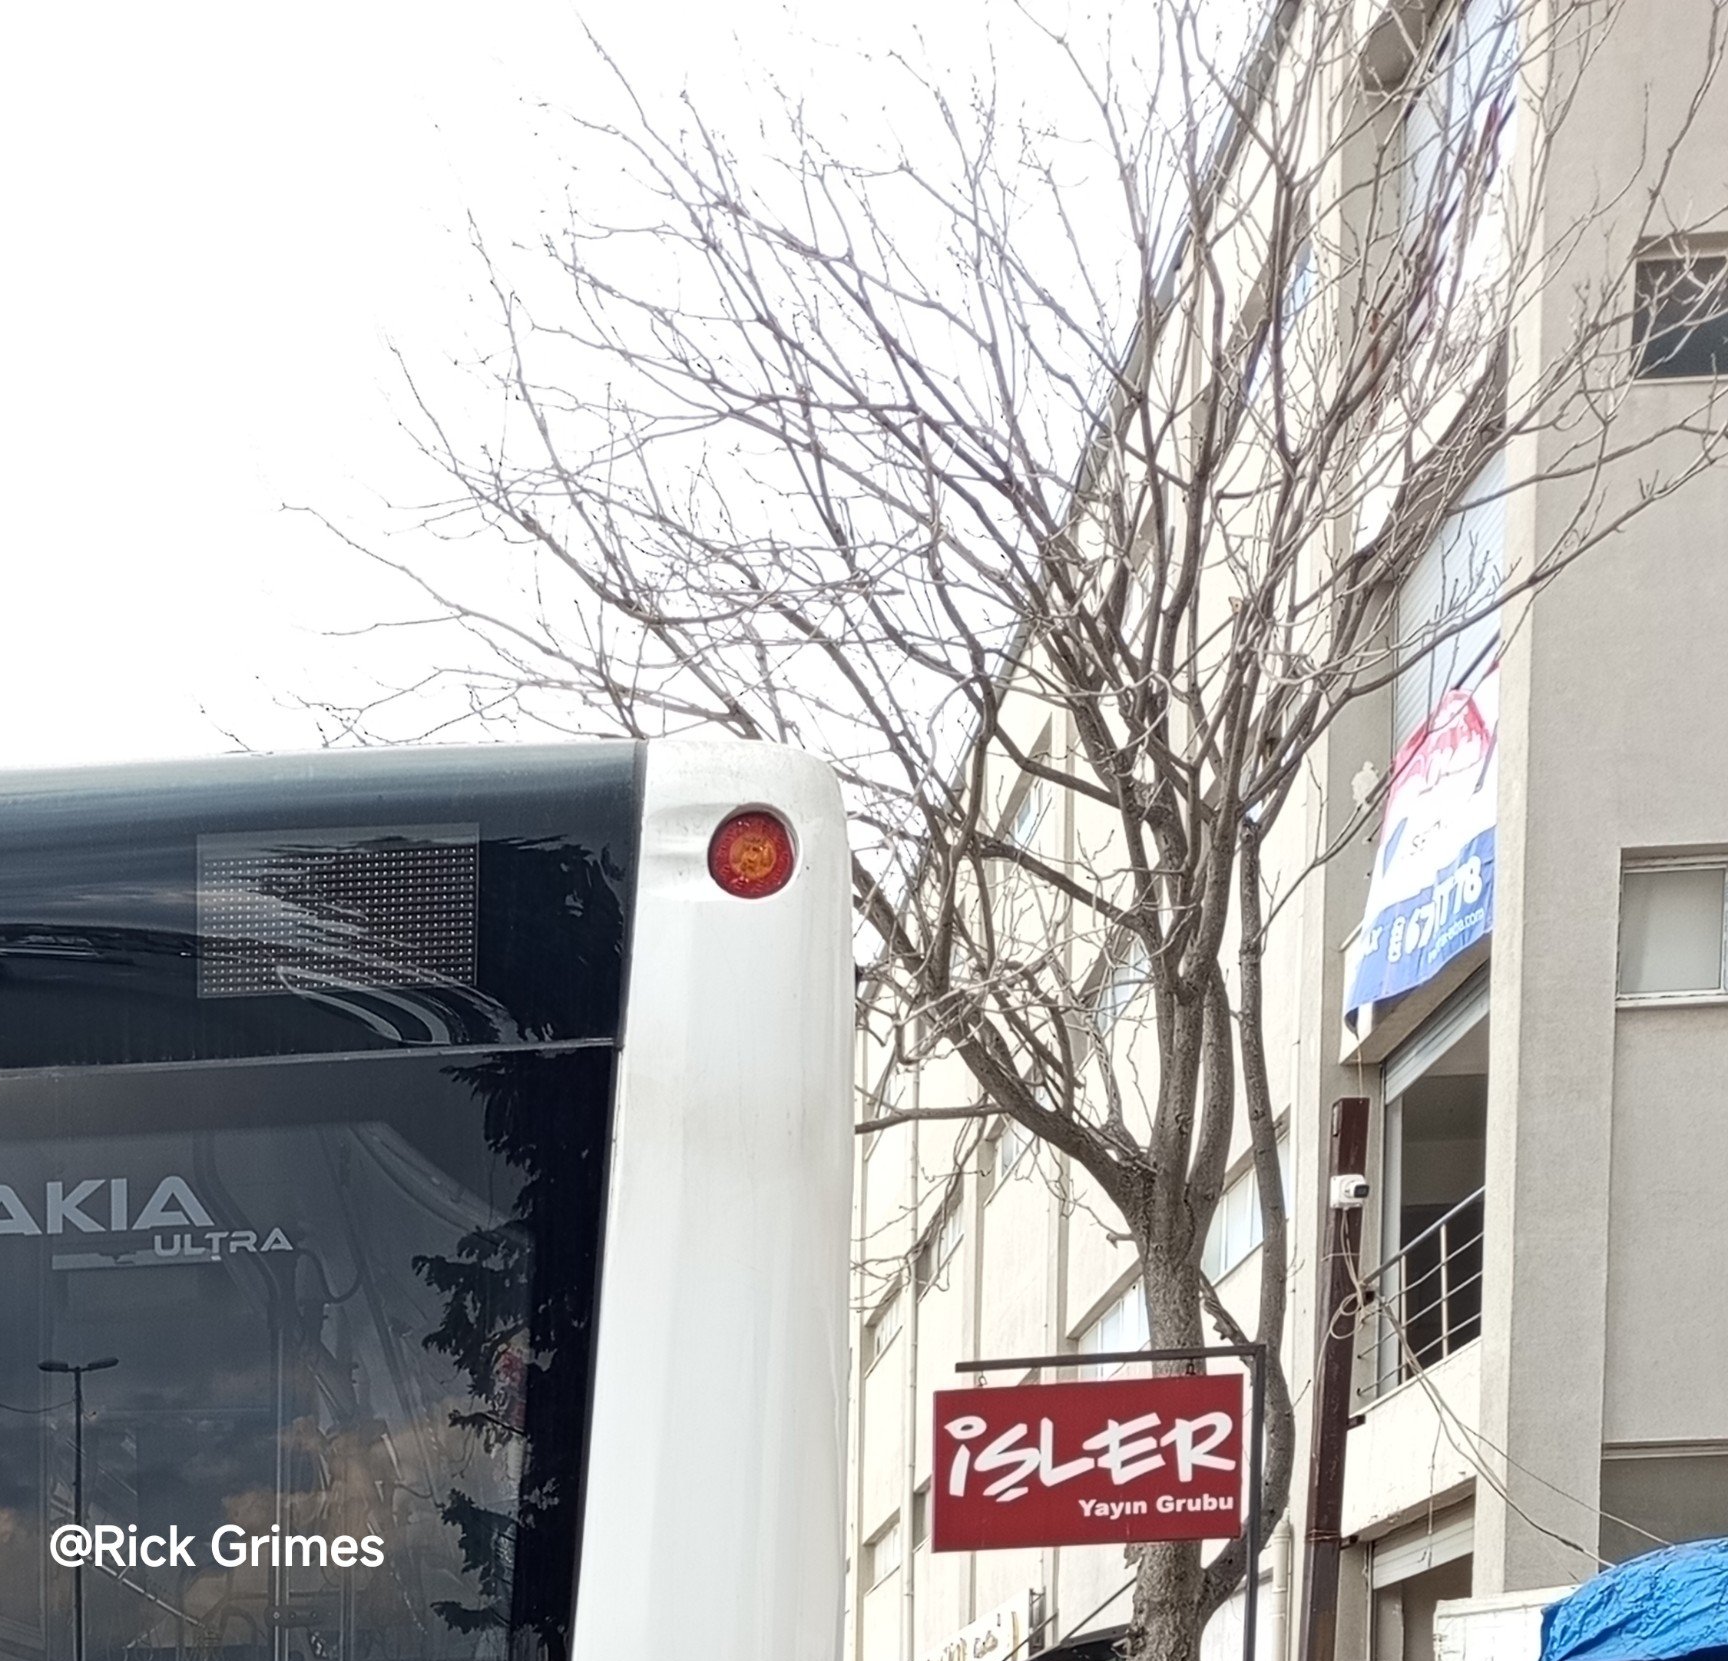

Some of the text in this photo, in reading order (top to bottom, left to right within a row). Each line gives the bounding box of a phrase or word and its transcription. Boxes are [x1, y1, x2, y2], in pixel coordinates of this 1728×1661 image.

[154, 1227, 294, 1256] ULTRA
[1078, 1494, 1234, 1519] Yayın Grubu
